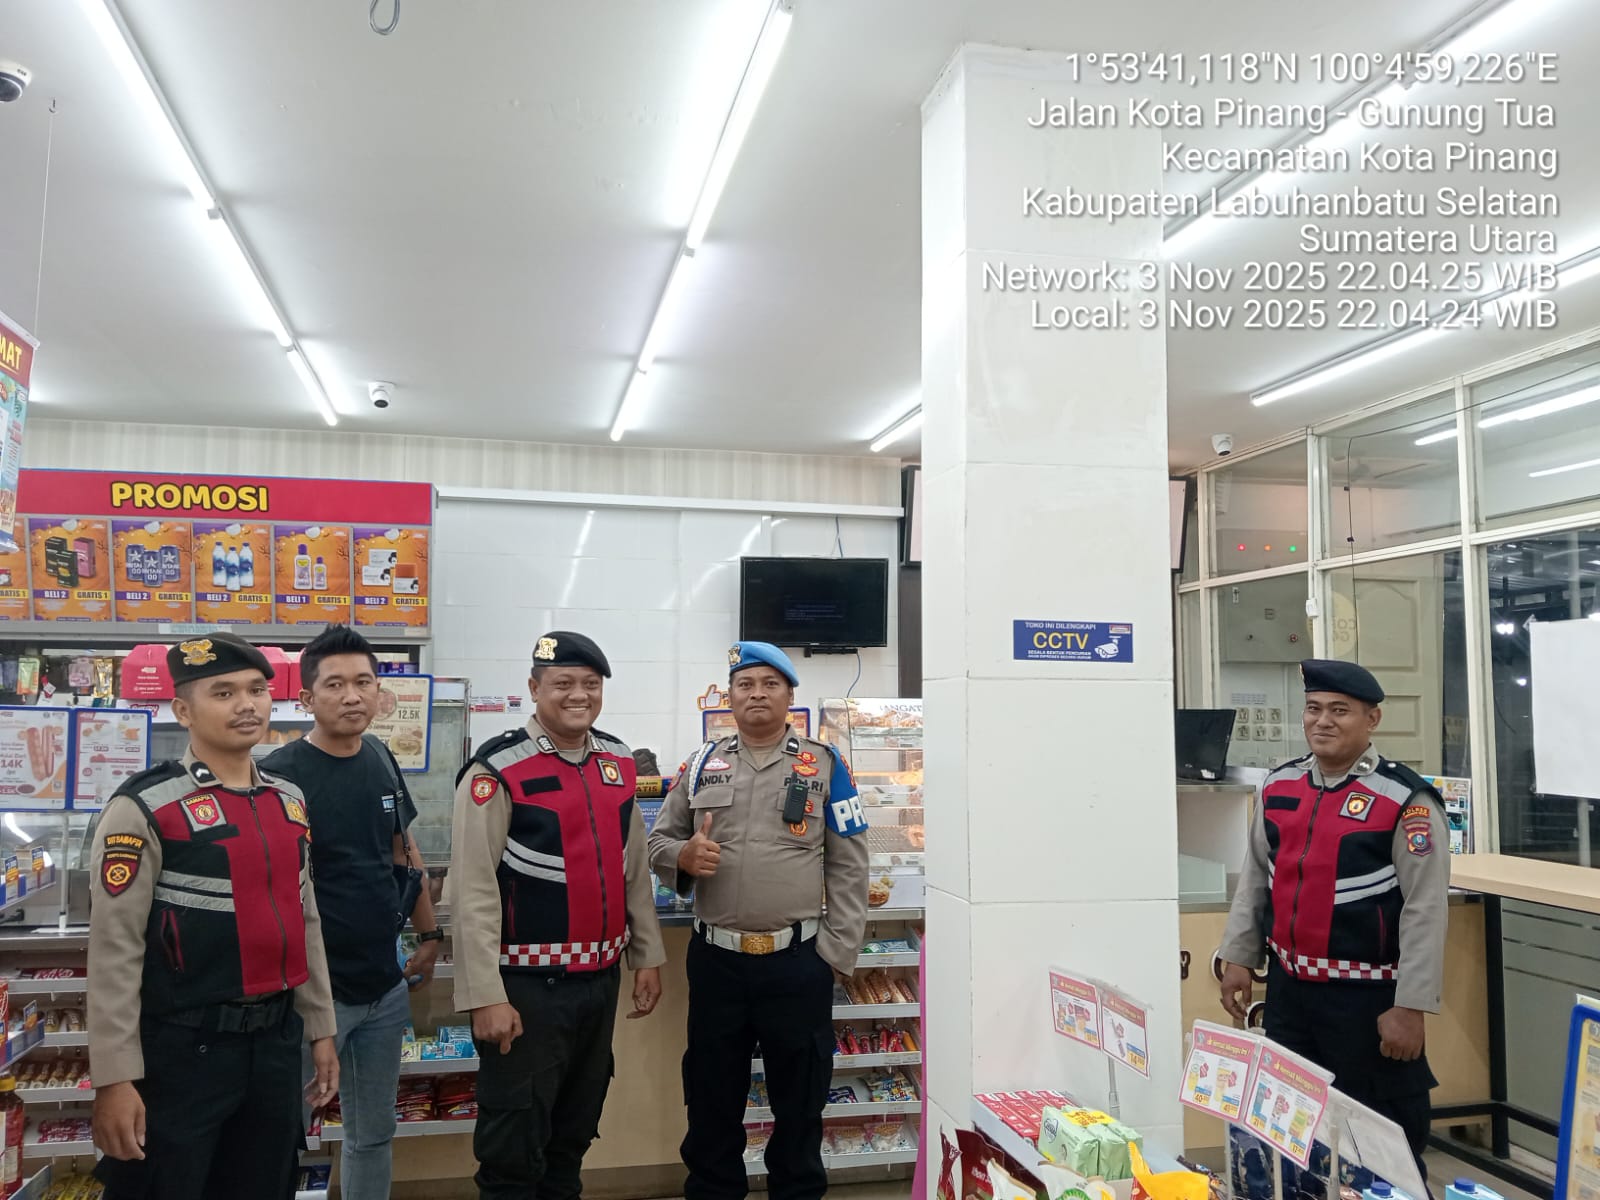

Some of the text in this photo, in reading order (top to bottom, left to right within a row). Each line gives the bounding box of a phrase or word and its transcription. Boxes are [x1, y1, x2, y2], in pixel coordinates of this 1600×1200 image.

[110, 481, 270, 512] PROMOSI
[44, 590, 61, 598] BELI
[77, 591, 103, 599] GRATIS
[126, 592, 142, 600] BELI
[206, 593, 222, 601] BELI
[238, 594, 263, 602] GRATIS
[286, 595, 301, 603] BELI
[317, 596, 342, 604] GRATIS
[1033, 631, 1089, 650] CCTV
[398, 710, 420, 719] 12.5K
[0, 759, 23, 768] 14K
